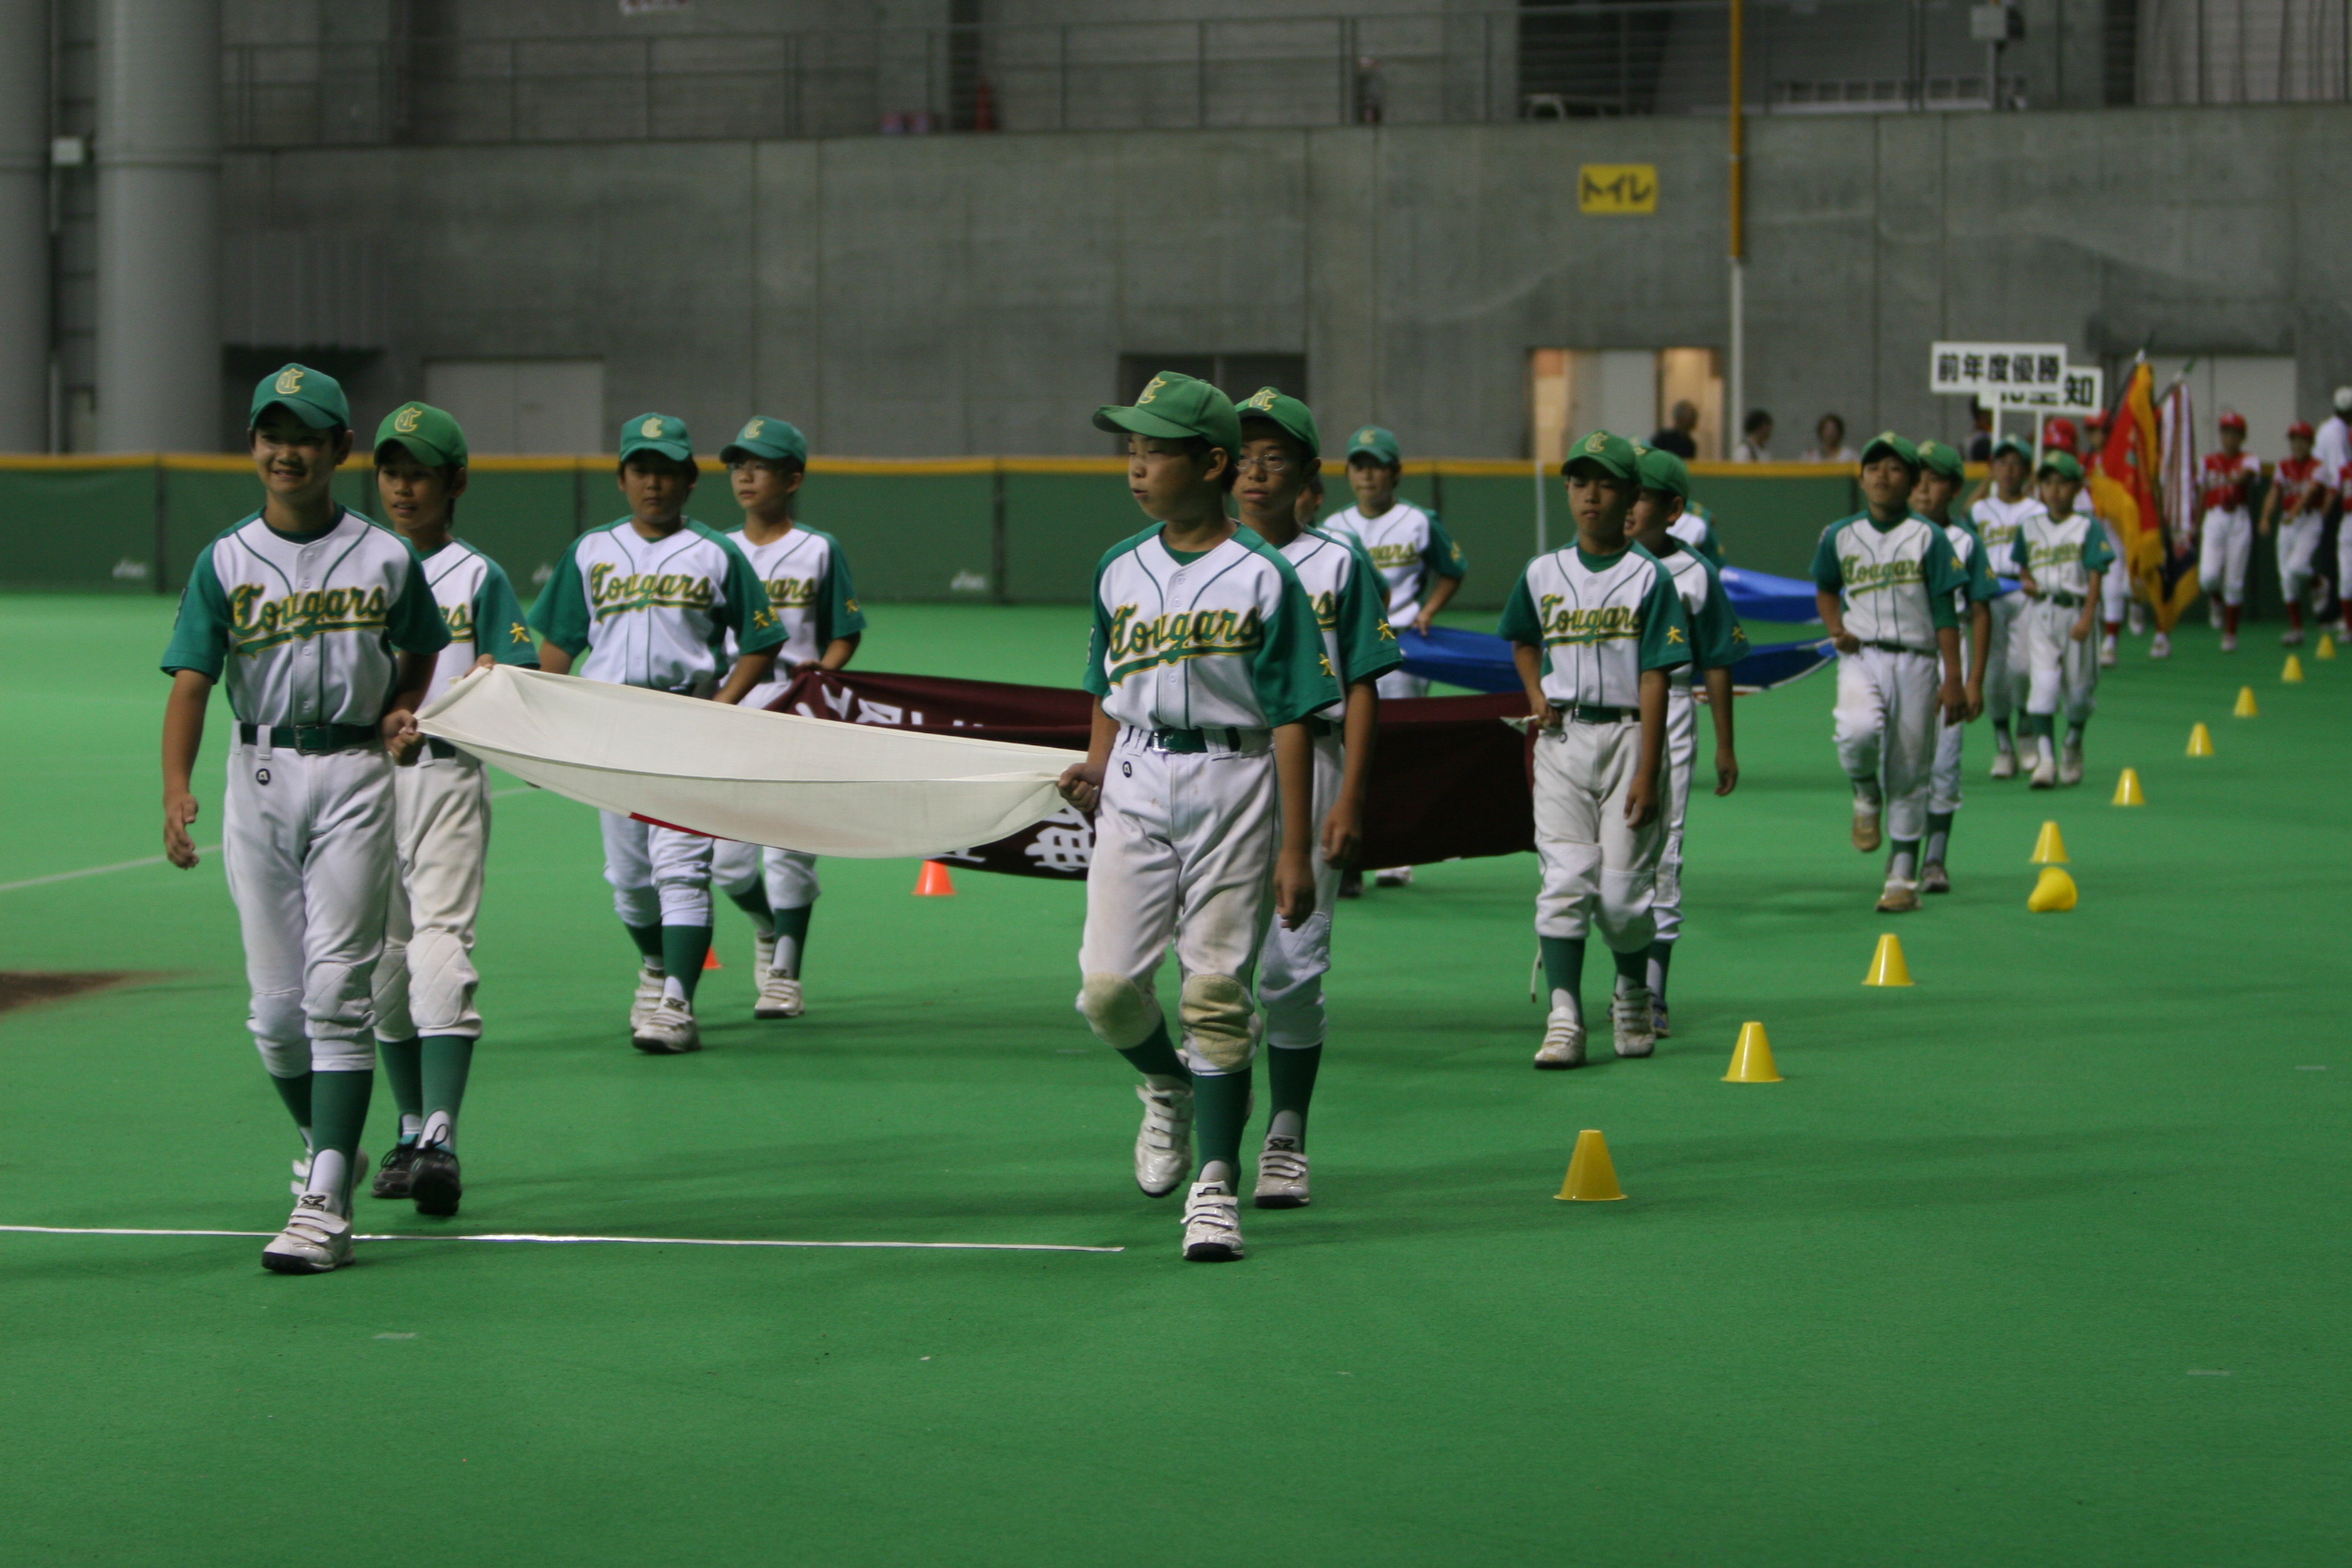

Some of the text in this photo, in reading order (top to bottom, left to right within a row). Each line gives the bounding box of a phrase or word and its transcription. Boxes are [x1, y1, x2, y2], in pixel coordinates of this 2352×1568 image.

[1582, 173, 1652, 203] トイレ
[1938, 352, 2060, 382] 前年度優勝
[591, 562, 713, 611] Cougars
[229, 582, 388, 641] Cougars
[1110, 603, 1264, 666] Cougars
